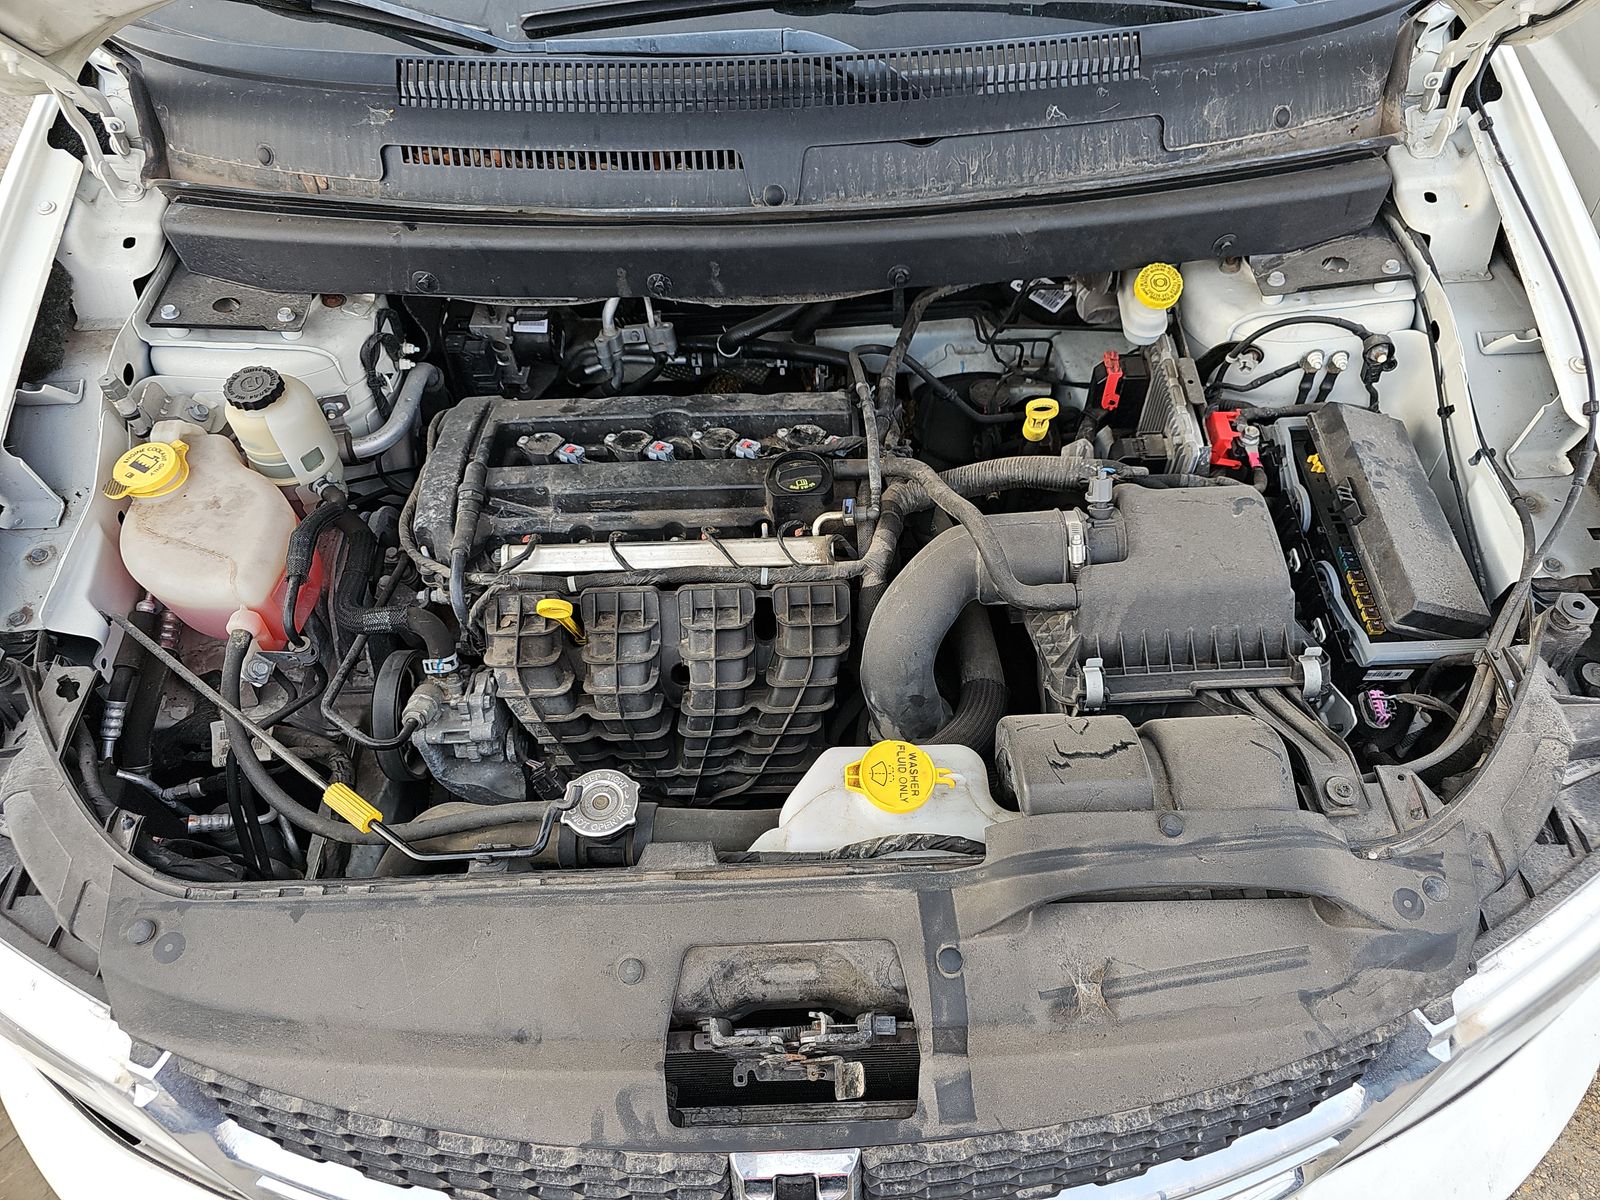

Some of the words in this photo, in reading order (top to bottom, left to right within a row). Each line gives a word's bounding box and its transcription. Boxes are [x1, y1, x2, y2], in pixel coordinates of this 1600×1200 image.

[896, 745, 906, 774] FLUID
[909, 753, 920, 796] WASHER
[899, 776, 908, 803] ONLY
[590, 818, 618, 831] OPEN
[617, 804, 632, 821] HOT
